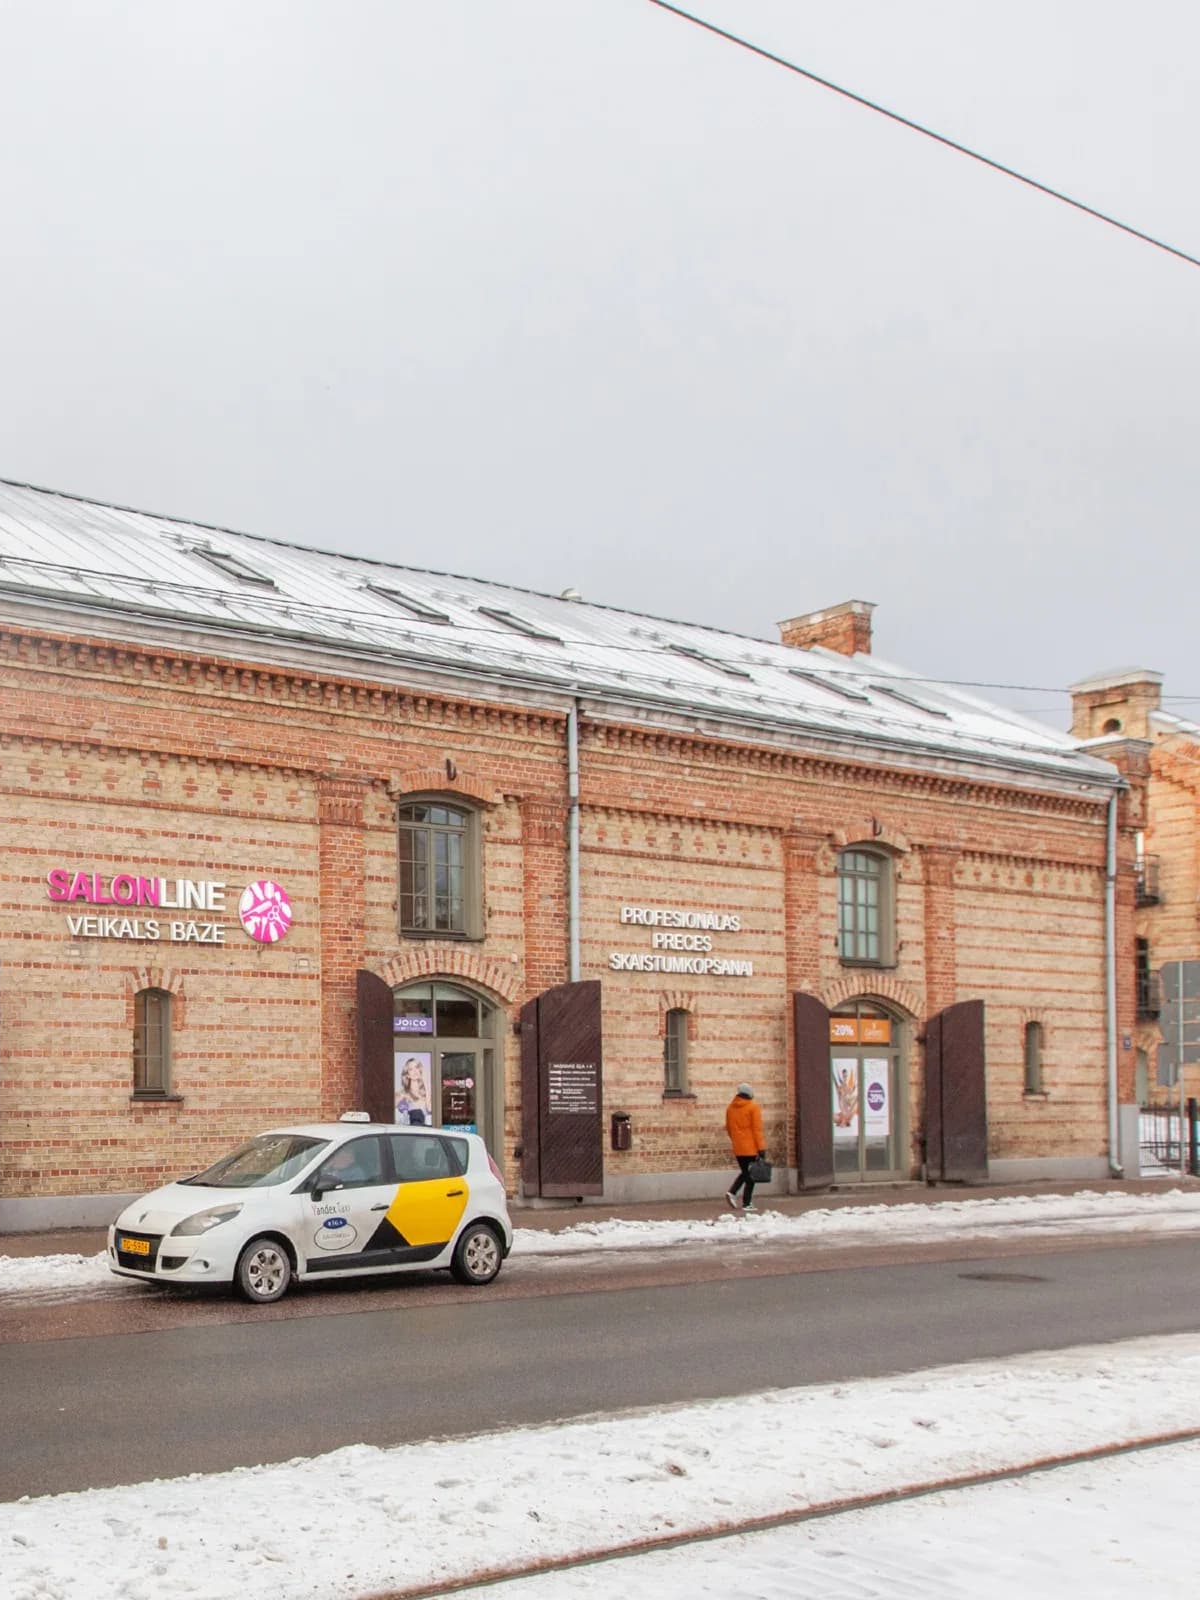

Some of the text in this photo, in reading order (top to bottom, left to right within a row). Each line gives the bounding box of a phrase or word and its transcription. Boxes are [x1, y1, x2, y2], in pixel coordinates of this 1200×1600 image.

[47, 868, 226, 911] SALONLINE
[66, 914, 226, 943] VEIKALS BĀZE
[620, 906, 740, 932] PROFESIONĀLAS
[652, 932, 712, 952] PRECES
[311, 1204, 337, 1217] Yandex
